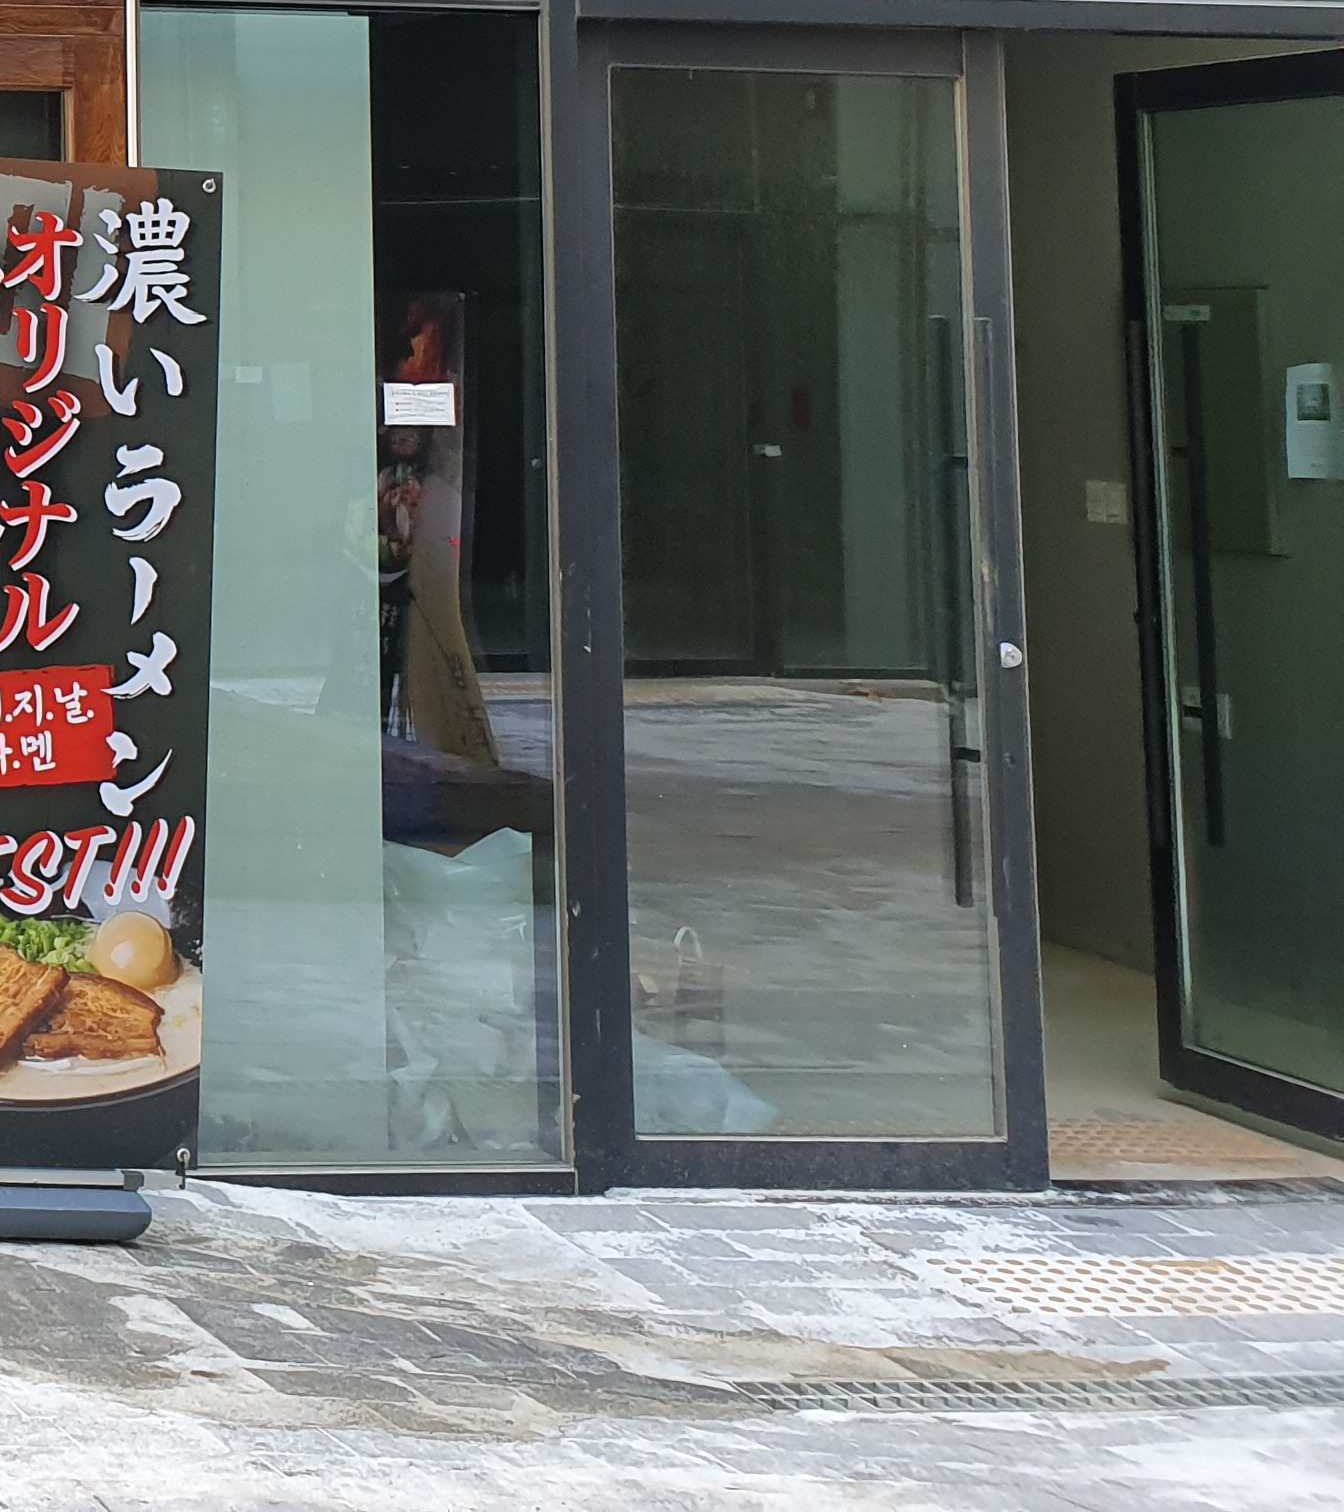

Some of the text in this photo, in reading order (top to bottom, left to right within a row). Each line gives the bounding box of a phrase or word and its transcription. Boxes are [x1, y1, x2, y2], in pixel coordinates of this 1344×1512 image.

[73, 197, 208, 817] 濃いラーメン
